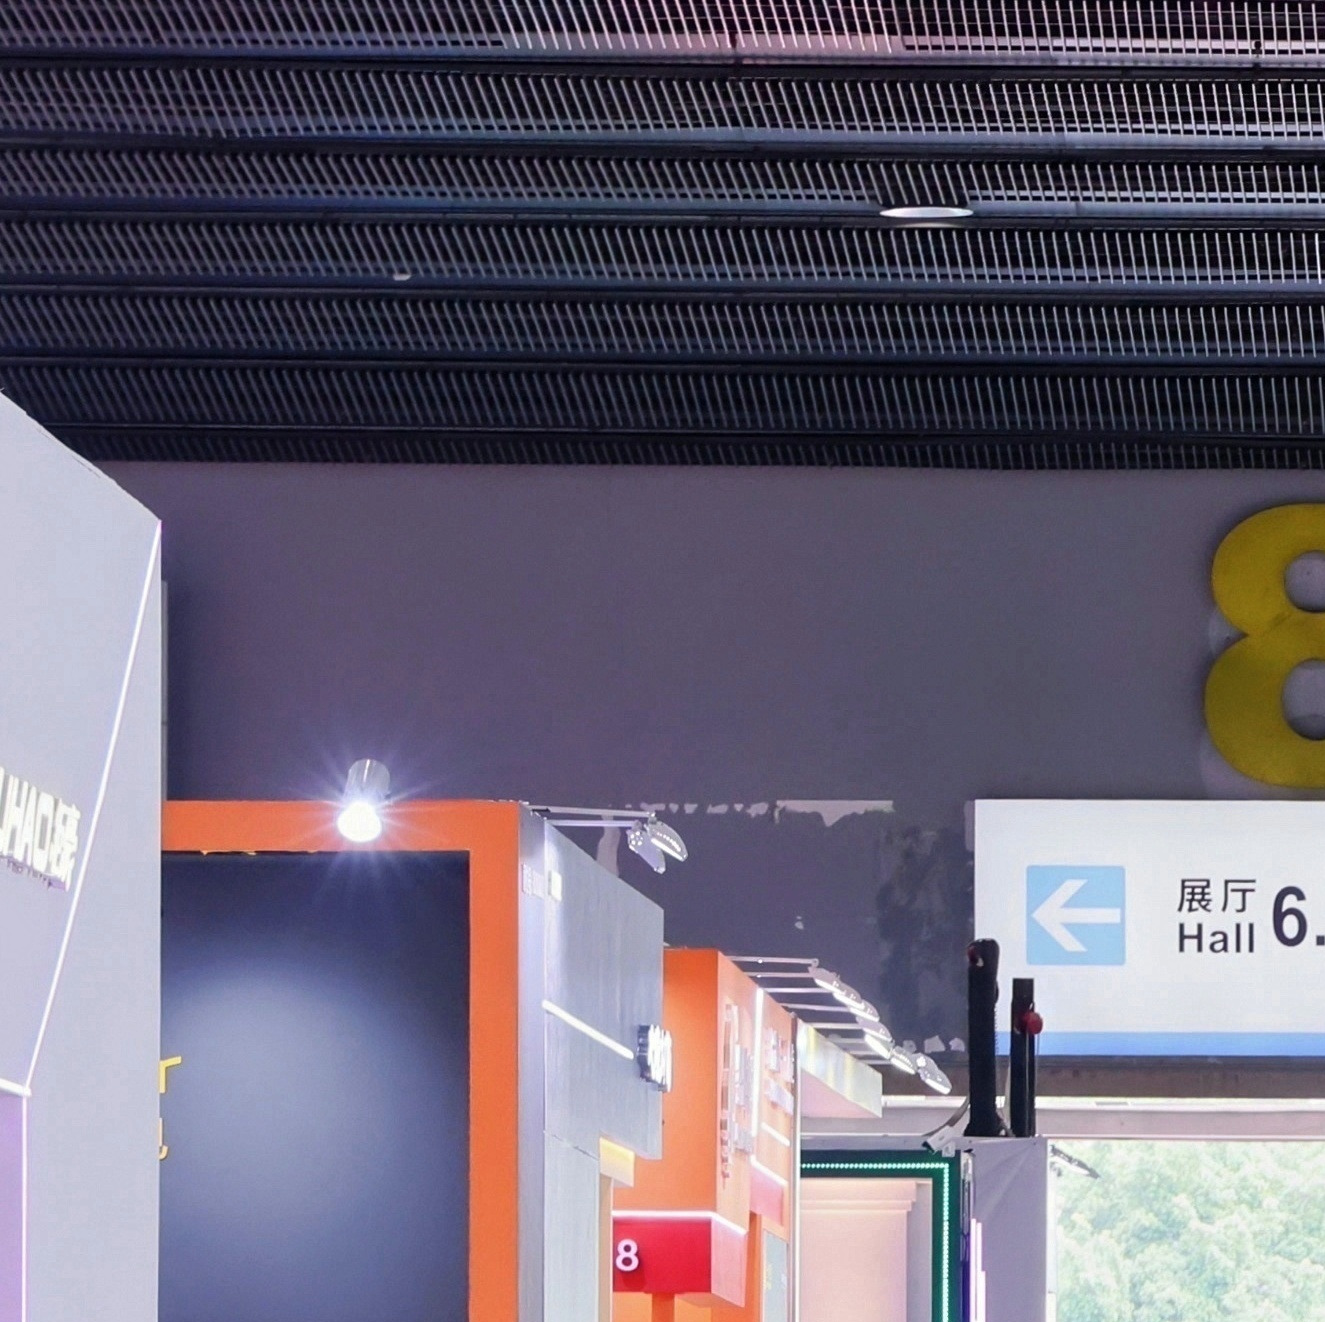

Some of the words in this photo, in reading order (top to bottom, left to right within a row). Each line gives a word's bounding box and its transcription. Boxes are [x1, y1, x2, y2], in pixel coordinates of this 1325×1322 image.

[1177, 876, 1257, 914] 展厅
[1178, 918, 1256, 955] Hall
[616, 1239, 639, 1272] 8
